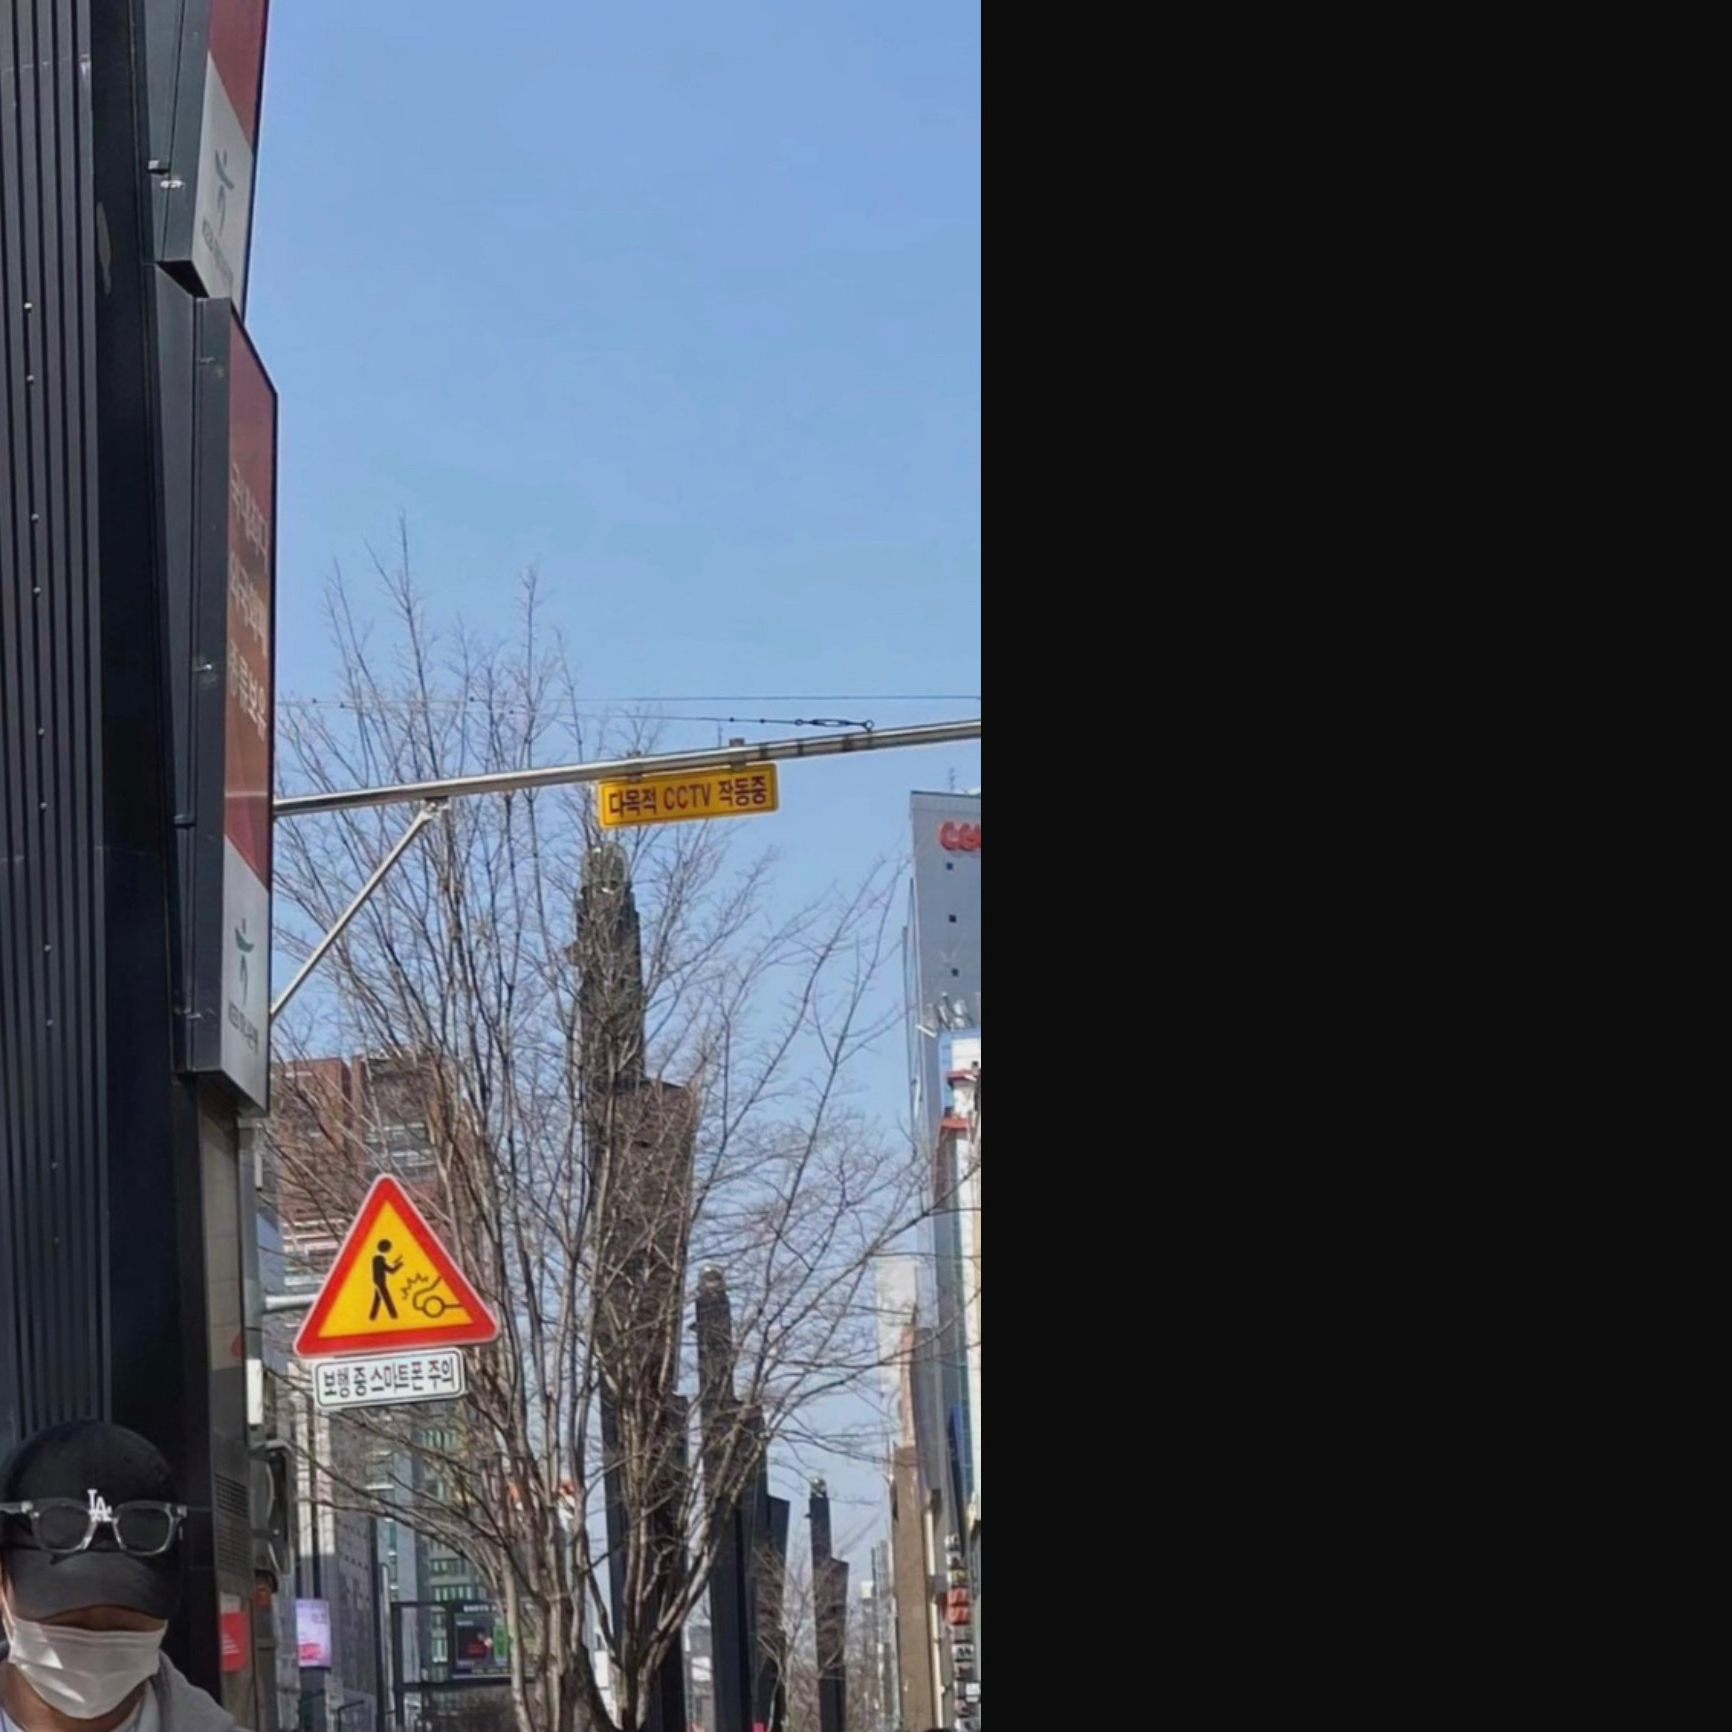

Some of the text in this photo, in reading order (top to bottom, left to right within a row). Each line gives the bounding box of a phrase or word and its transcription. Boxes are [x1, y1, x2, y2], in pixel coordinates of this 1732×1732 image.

[609, 775, 767, 818] 다목적 CCTV 작동중
[324, 1356, 456, 1398] 보행 중 스마트폰 주의
[87, 1489, 113, 1523] LA
